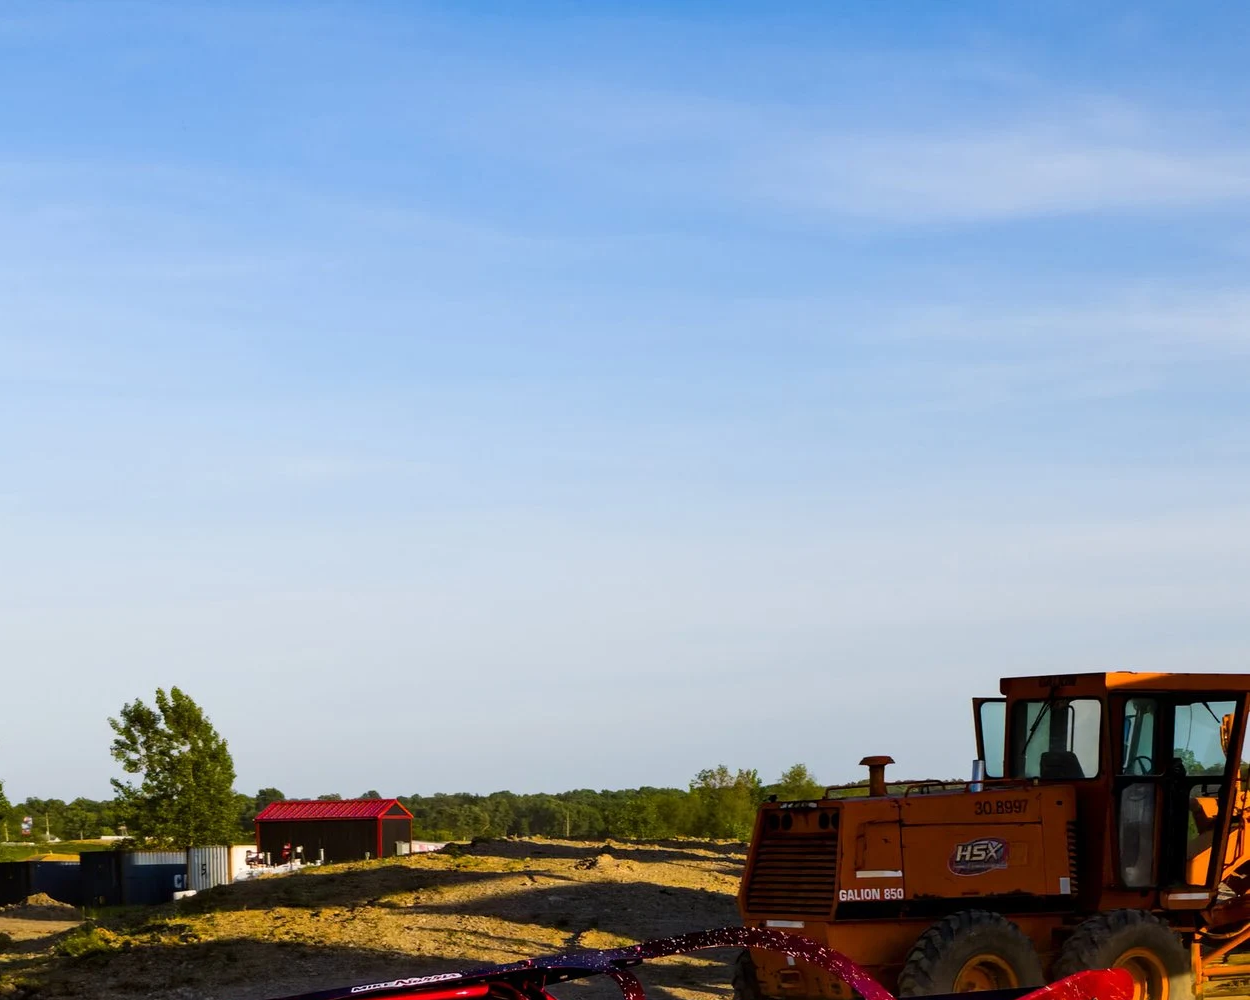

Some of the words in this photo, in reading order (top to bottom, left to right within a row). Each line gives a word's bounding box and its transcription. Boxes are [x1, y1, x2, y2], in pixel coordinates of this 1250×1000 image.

[956, 841, 1003, 862] HSX
[839, 888, 880, 901] GALION
[884, 888, 904, 899] 850
